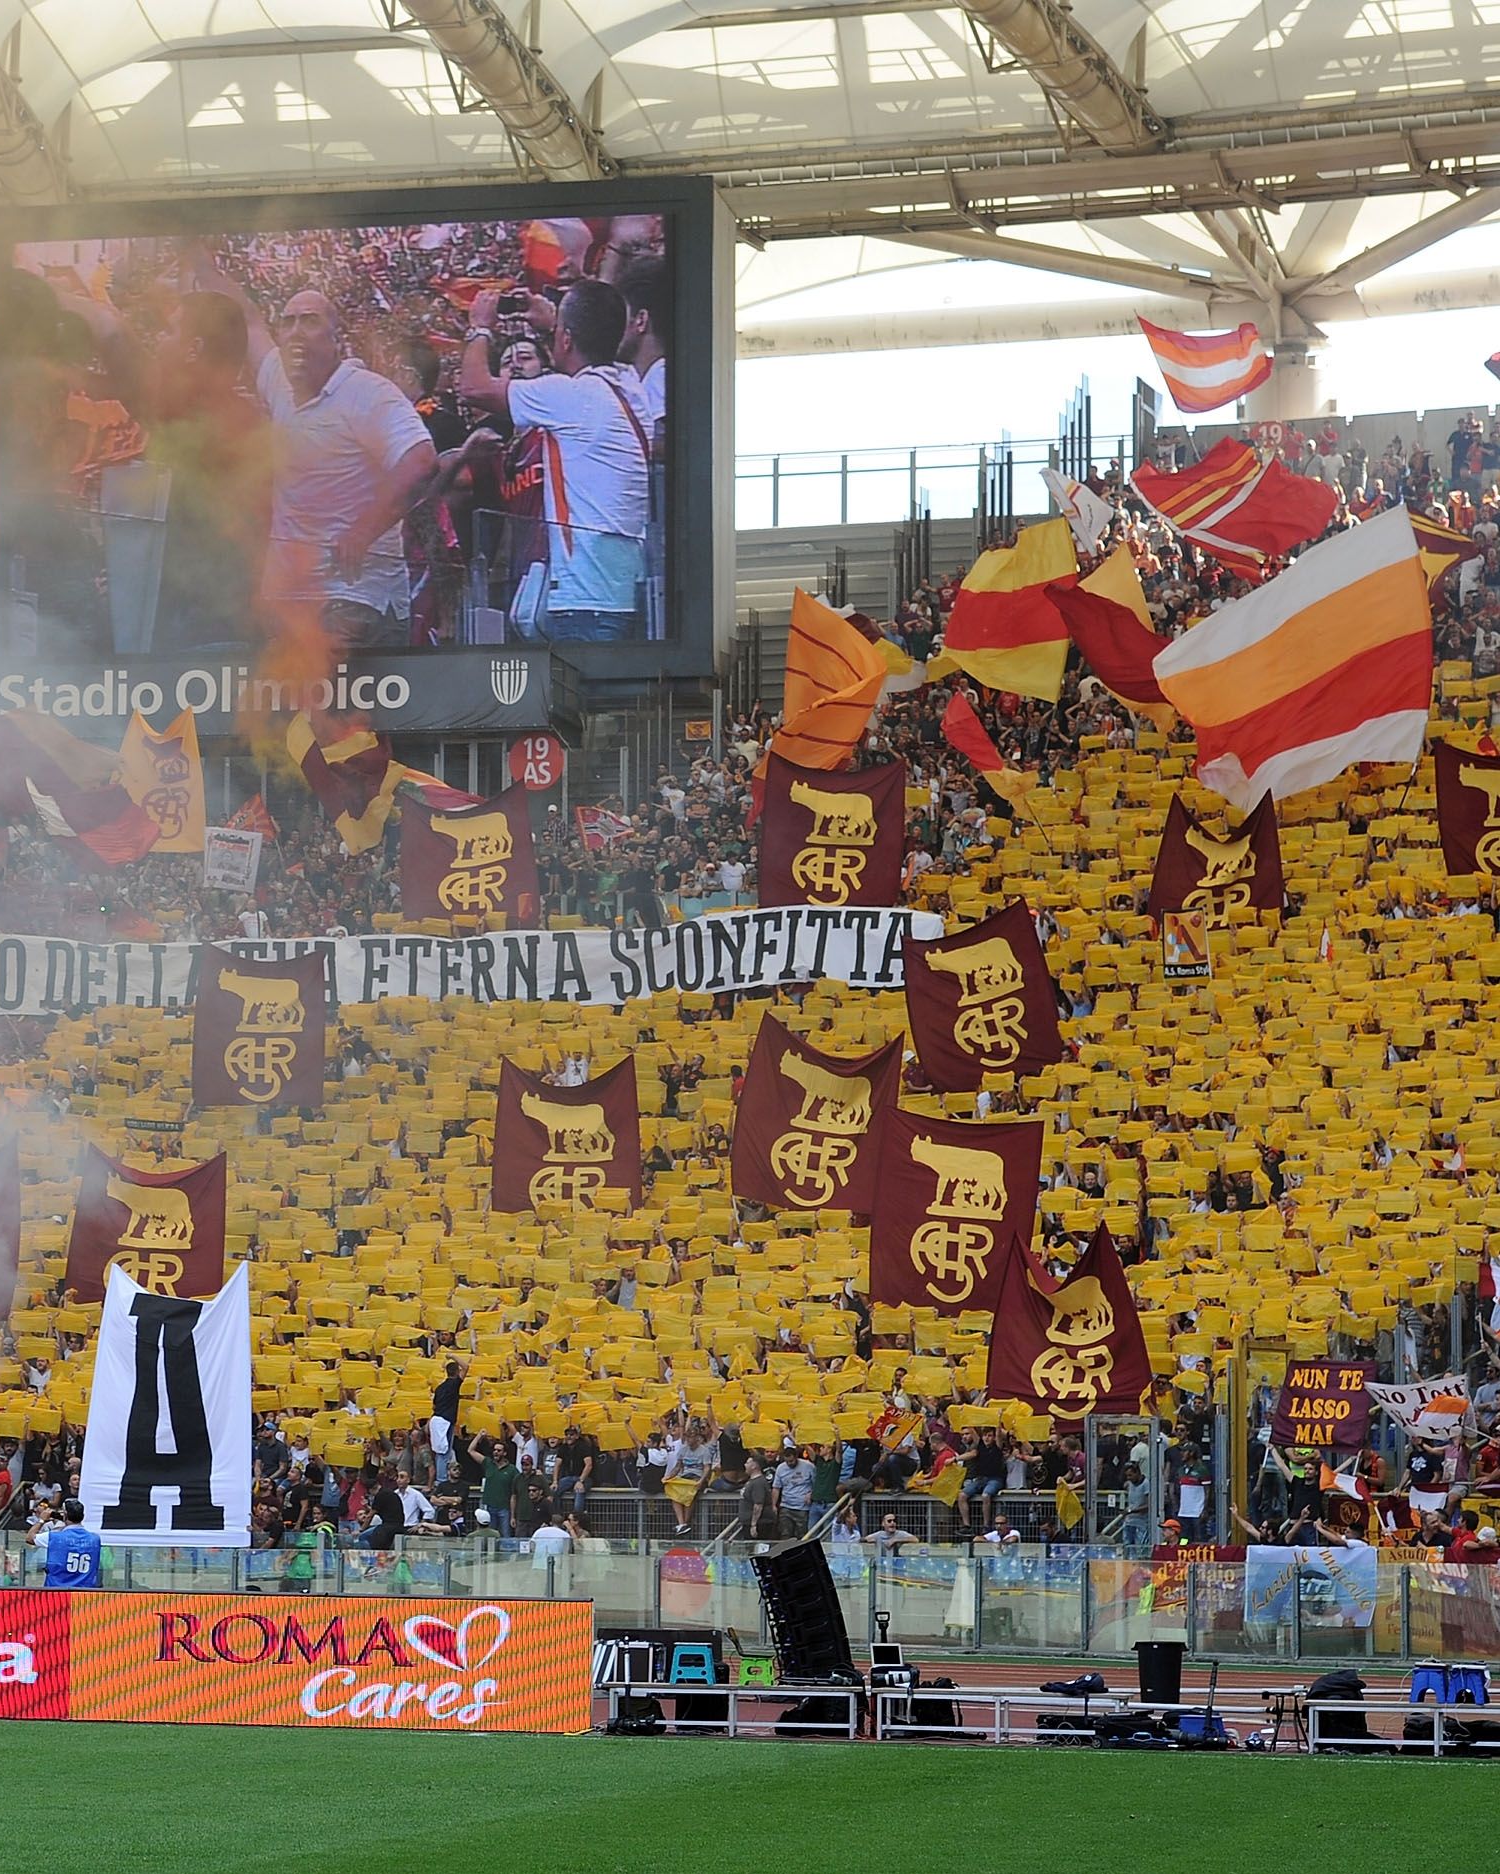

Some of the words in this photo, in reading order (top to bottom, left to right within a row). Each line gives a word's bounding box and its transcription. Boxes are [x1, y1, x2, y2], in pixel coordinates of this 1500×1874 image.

[1259, 424, 1282, 444] 19
[491, 660, 528, 671] Italia
[0, 670, 163, 717] Stadio
[176, 664, 410, 720] Olimpico
[524, 738, 549, 760] 19
[524, 762, 551, 784] AS
[359, 931, 591, 1005] ETERNA
[609, 910, 913, 1000] SCONFITTA
[1177, 967, 1195, 976] Roma
[1290, 1369, 1329, 1390] NUN
[1339, 1370, 1364, 1391] TE
[1372, 1388, 1406, 1405] No
[1288, 1397, 1350, 1420] LASSO
[1294, 1423, 1333, 1445] MAI
[66, 1552, 92, 1574] 56
[154, 1612, 417, 1667] ROMA
[301, 1667, 509, 1724] Cares
